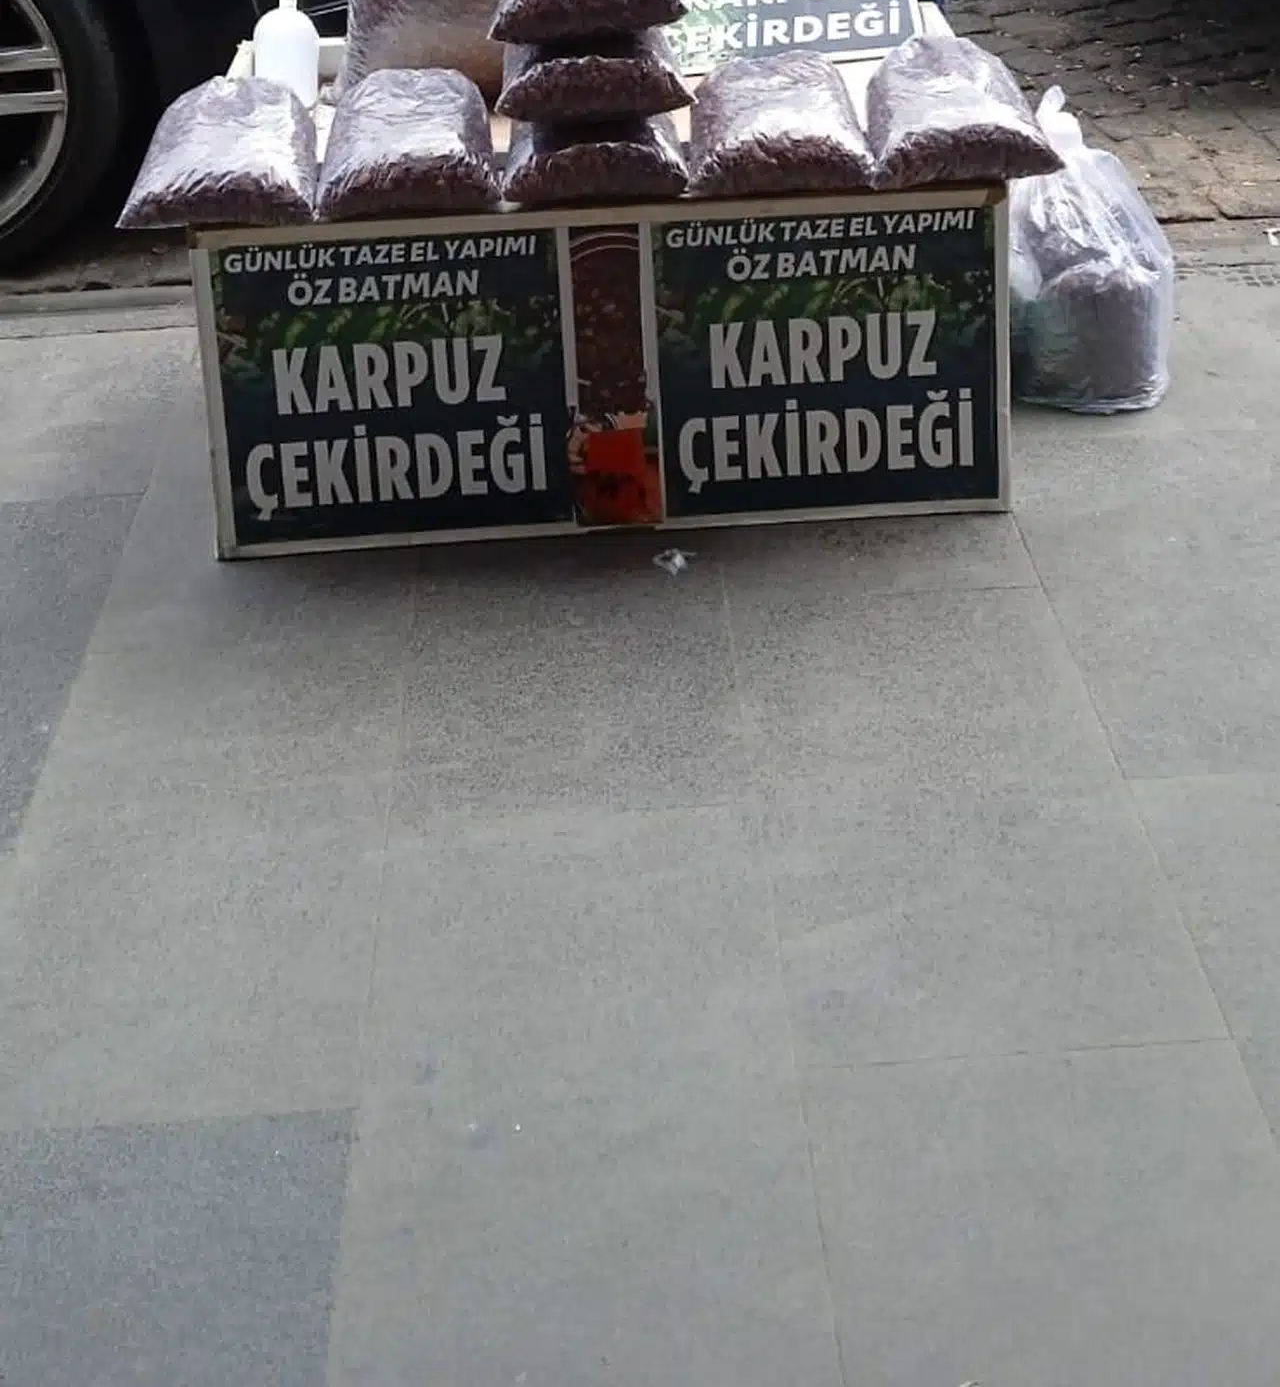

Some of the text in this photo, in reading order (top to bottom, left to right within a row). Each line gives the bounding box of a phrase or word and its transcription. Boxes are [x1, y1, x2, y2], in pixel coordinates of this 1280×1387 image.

[224, 235, 537, 273] GÜNLÜK TAZE EL YAPIMI
[666, 209, 975, 248] GÜNLÜK TAZE EL YAPIMI
[287, 269, 480, 307] ÖZ BATMAN
[726, 244, 916, 282] ÖZ BATMAN
[272, 333, 507, 416] KARPUZ
[709, 308, 938, 389] KARPUZ
[246, 413, 548, 521] ÇEKİRDEĞİ
[678, 387, 975, 493] ÇEKİRDEĞİ
